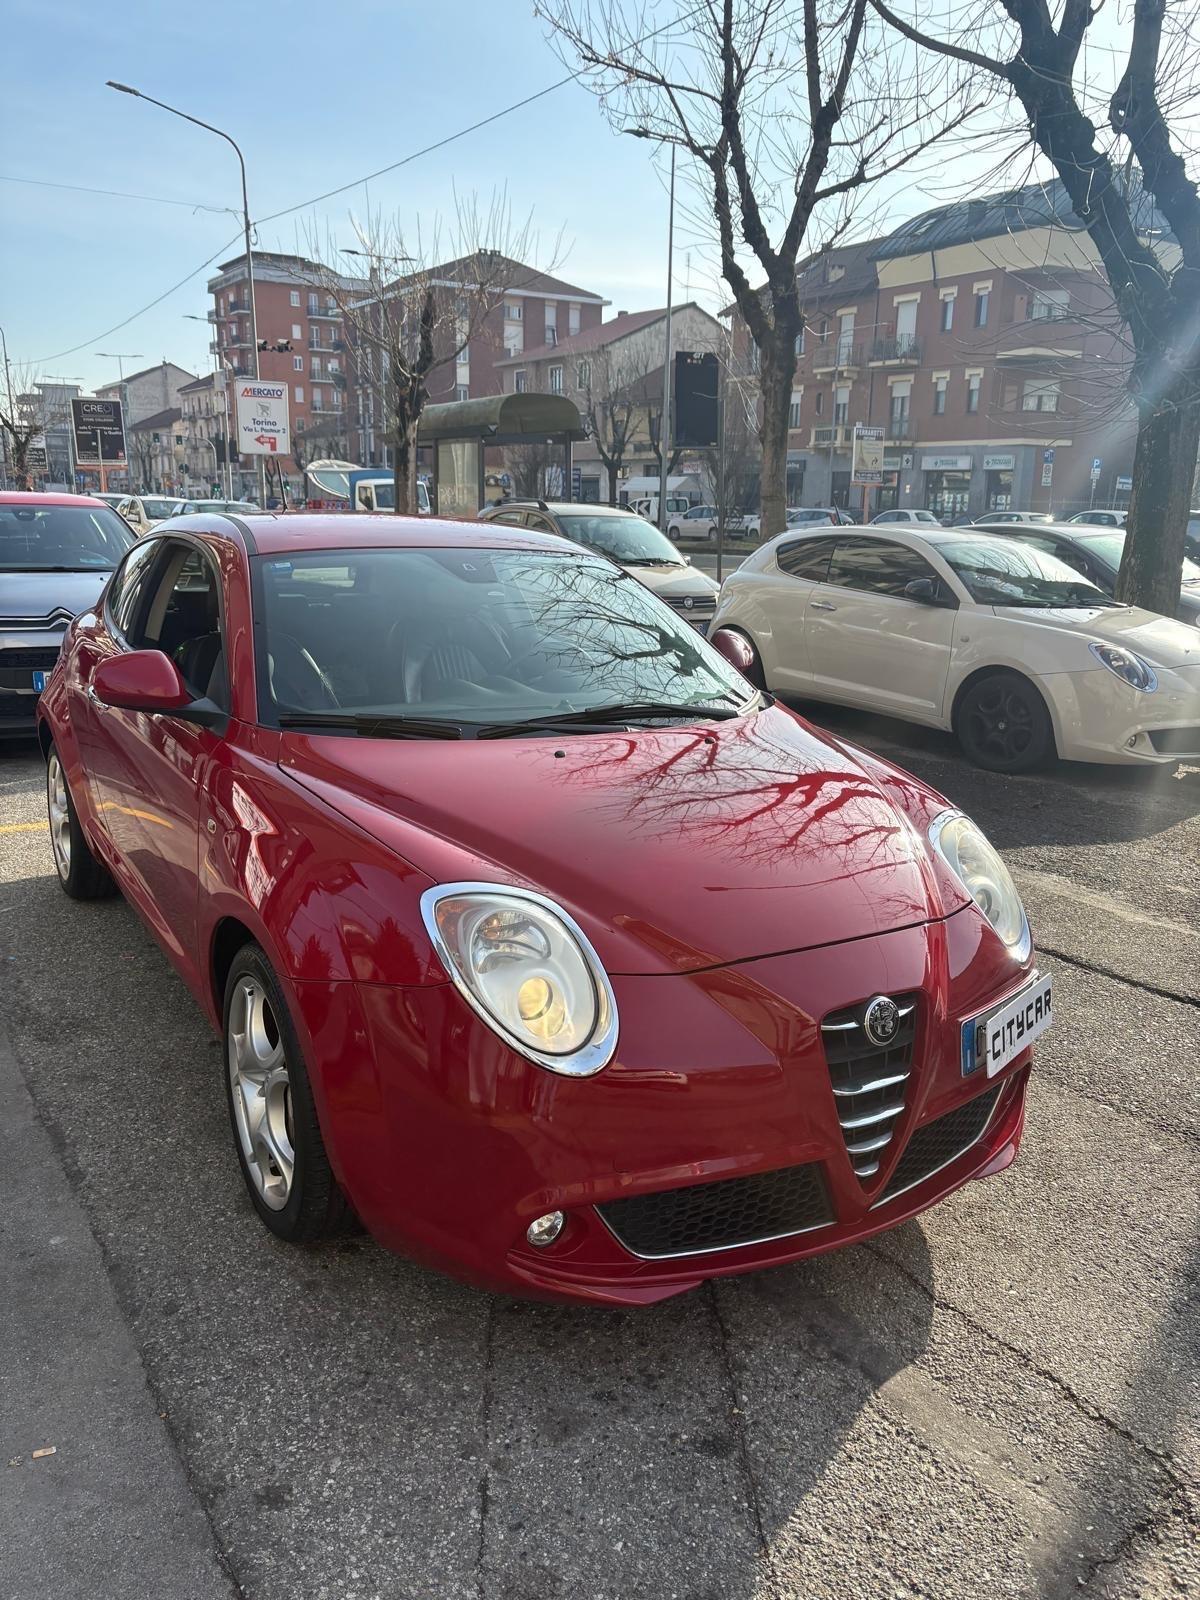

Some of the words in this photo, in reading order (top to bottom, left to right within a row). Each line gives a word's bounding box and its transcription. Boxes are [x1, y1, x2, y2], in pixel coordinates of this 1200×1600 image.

[252, 418, 277, 426] Torino
[1094, 459, 1100, 468] P
[992, 988, 1052, 1061] CITYCAR
